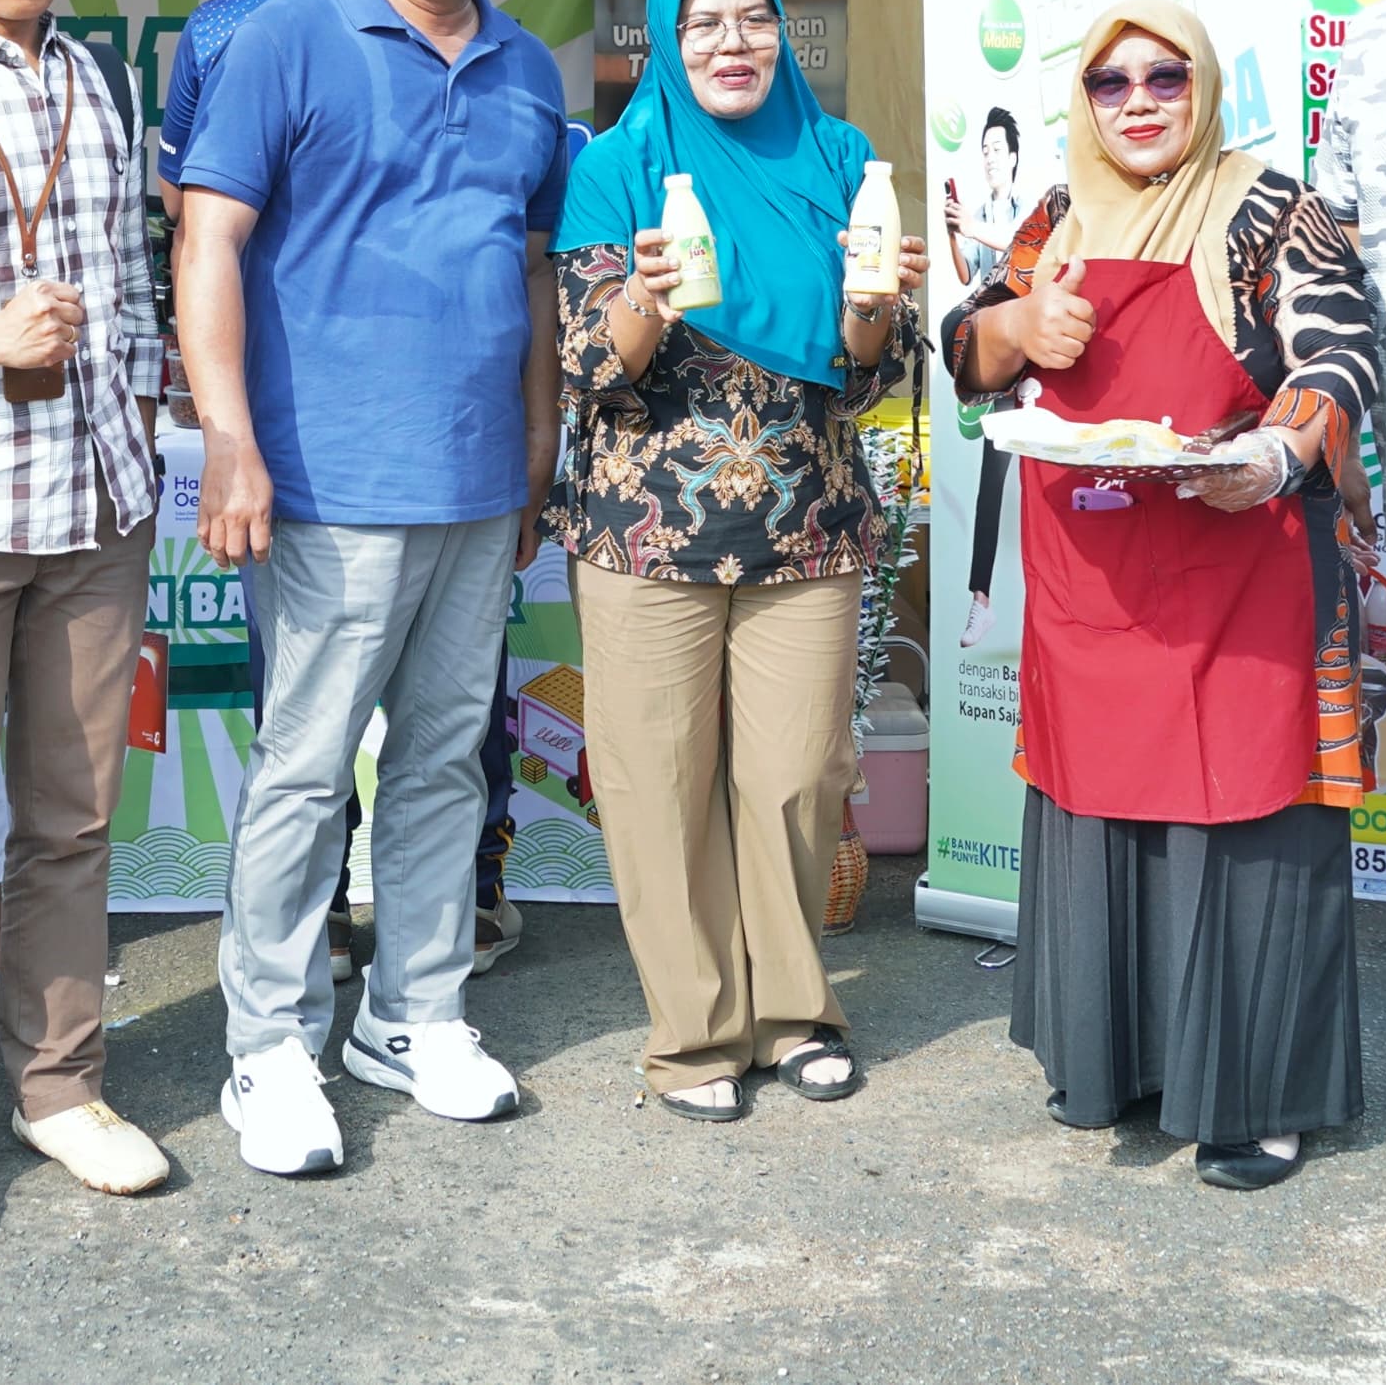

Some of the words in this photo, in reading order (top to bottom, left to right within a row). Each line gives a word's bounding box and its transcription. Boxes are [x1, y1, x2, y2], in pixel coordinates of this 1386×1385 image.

[175, 476, 199, 490] Ha
[190, 581, 247, 622] BA
[959, 659, 999, 681] dengan
[959, 681, 1006, 700] transaksi
[1009, 686, 1018, 702] bi
[959, 700, 995, 721] Kapan
[951, 837, 978, 852] BANK
[951, 850, 979, 865] PUNYE
[980, 843, 1019, 871] KITE
